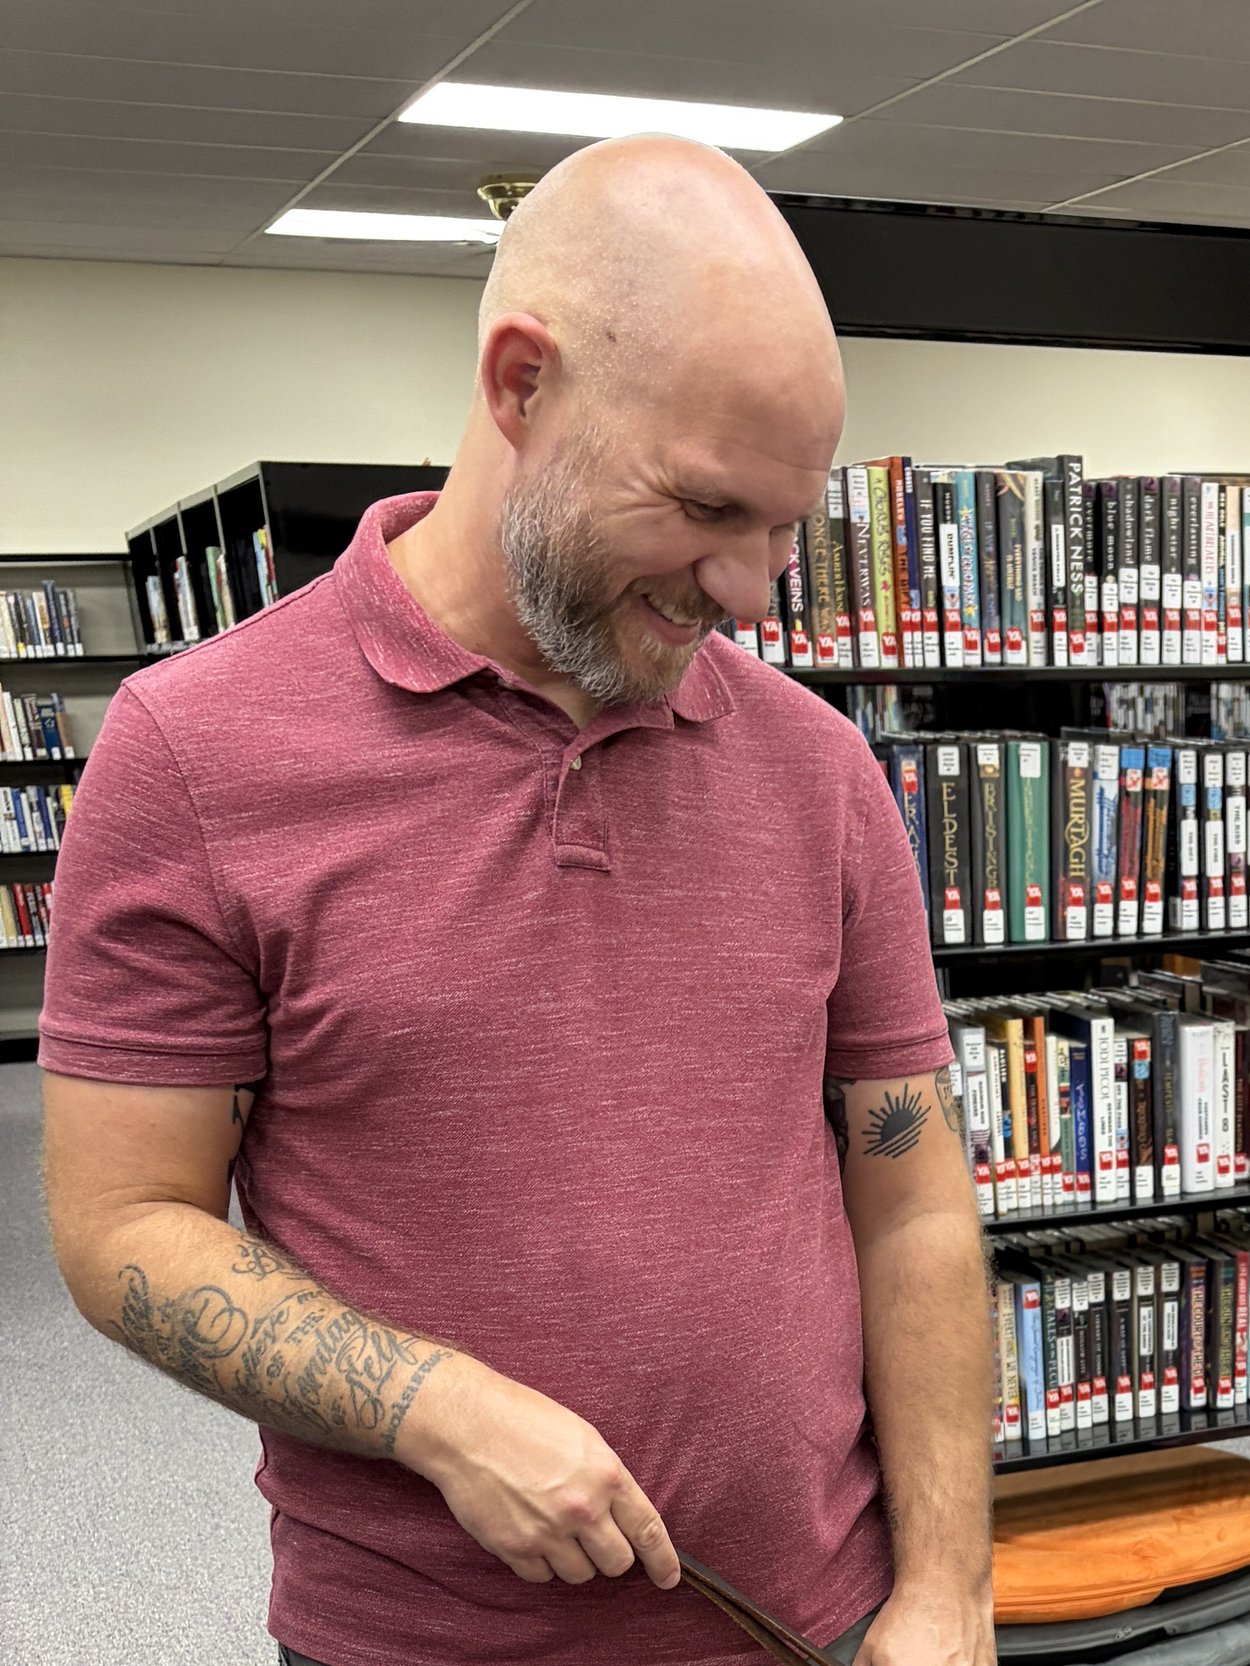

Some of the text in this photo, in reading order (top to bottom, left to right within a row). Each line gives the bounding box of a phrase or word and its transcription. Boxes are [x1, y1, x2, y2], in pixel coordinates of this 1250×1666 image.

[921, 512, 934, 535] YOU
[1069, 462, 1084, 594] PATRICK NESS
[1107, 502, 1117, 569] blue moon
[1125, 495, 1135, 564] shadowland
[789, 568, 804, 613] VEINS
[942, 782, 958, 886] ELDEST
[1065, 779, 1090, 877] MURTAGH
[1193, 1286, 1204, 1305] THE
[1193, 1307, 1204, 1338] COURT
[1048, 1360, 1058, 1389] PECU
[1193, 1349, 1204, 1367] THE
